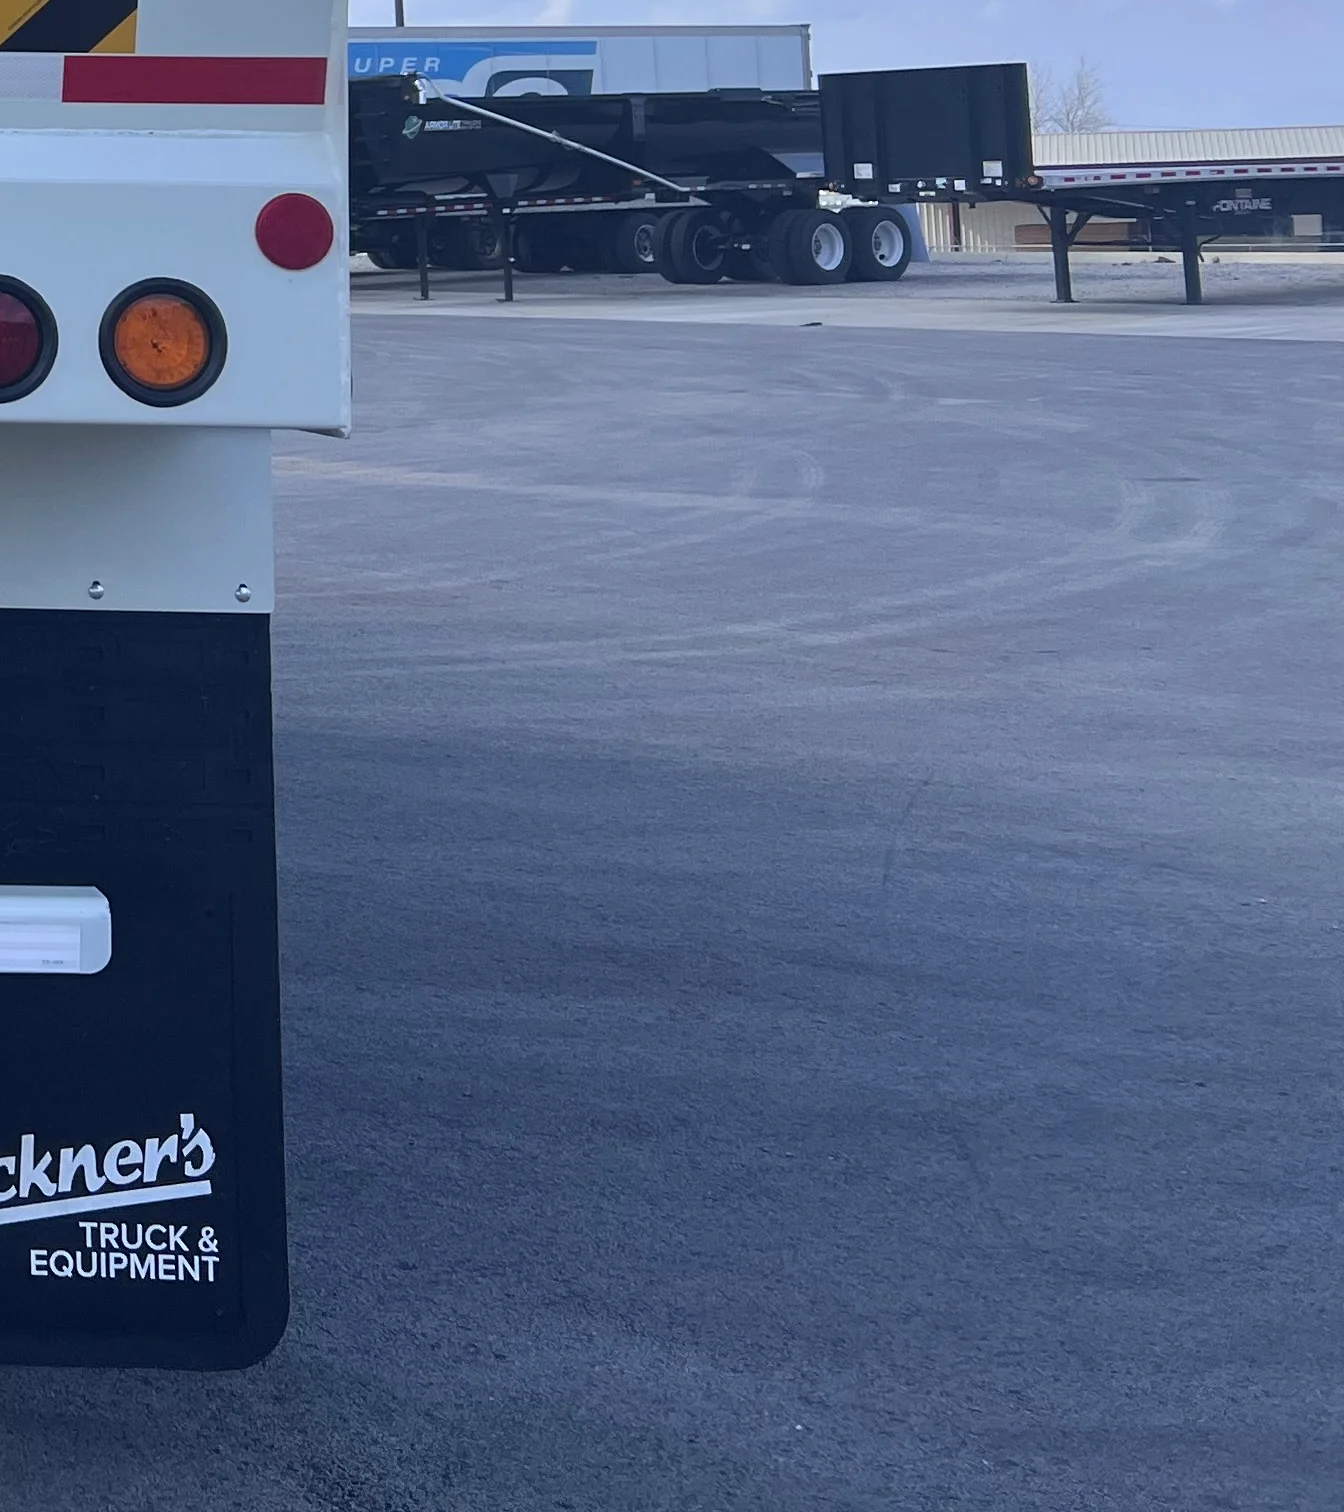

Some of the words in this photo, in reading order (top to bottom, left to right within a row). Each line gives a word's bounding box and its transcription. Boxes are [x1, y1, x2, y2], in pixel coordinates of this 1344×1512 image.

[354, 57, 440, 73] UPER
[78, 1221, 189, 1252] TRUCK
[198, 1226, 219, 1253] &
[30, 1249, 220, 1282] EQUIPMENT
